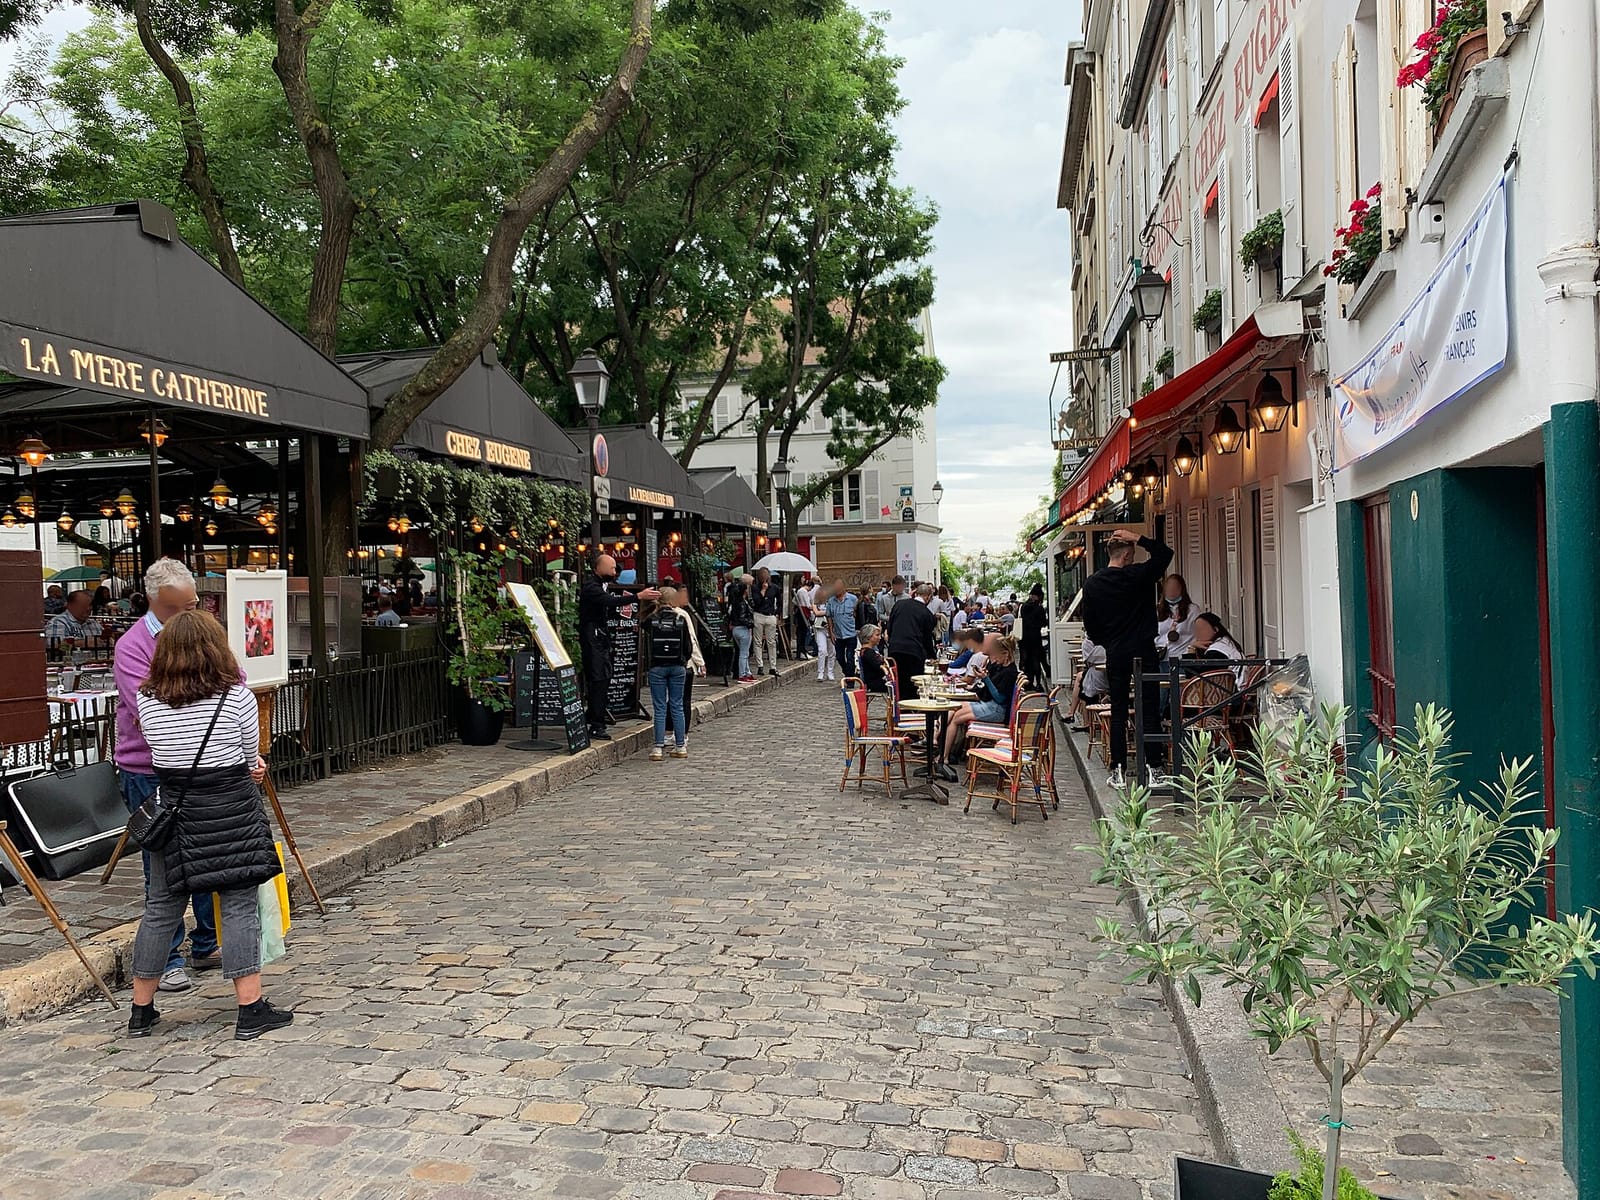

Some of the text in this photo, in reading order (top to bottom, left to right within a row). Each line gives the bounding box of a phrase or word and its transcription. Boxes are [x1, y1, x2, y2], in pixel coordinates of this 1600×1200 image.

[1193, 91, 1227, 193] CHEZ
[1233, 0, 1303, 124] EUGEN
[1455, 310, 1477, 332] ENIRS
[21, 338, 270, 418] LA MERE CATHERINE
[446, 430, 532, 470] CHEZ EUGENE
[1057, 437, 1103, 450] RESTAURA
